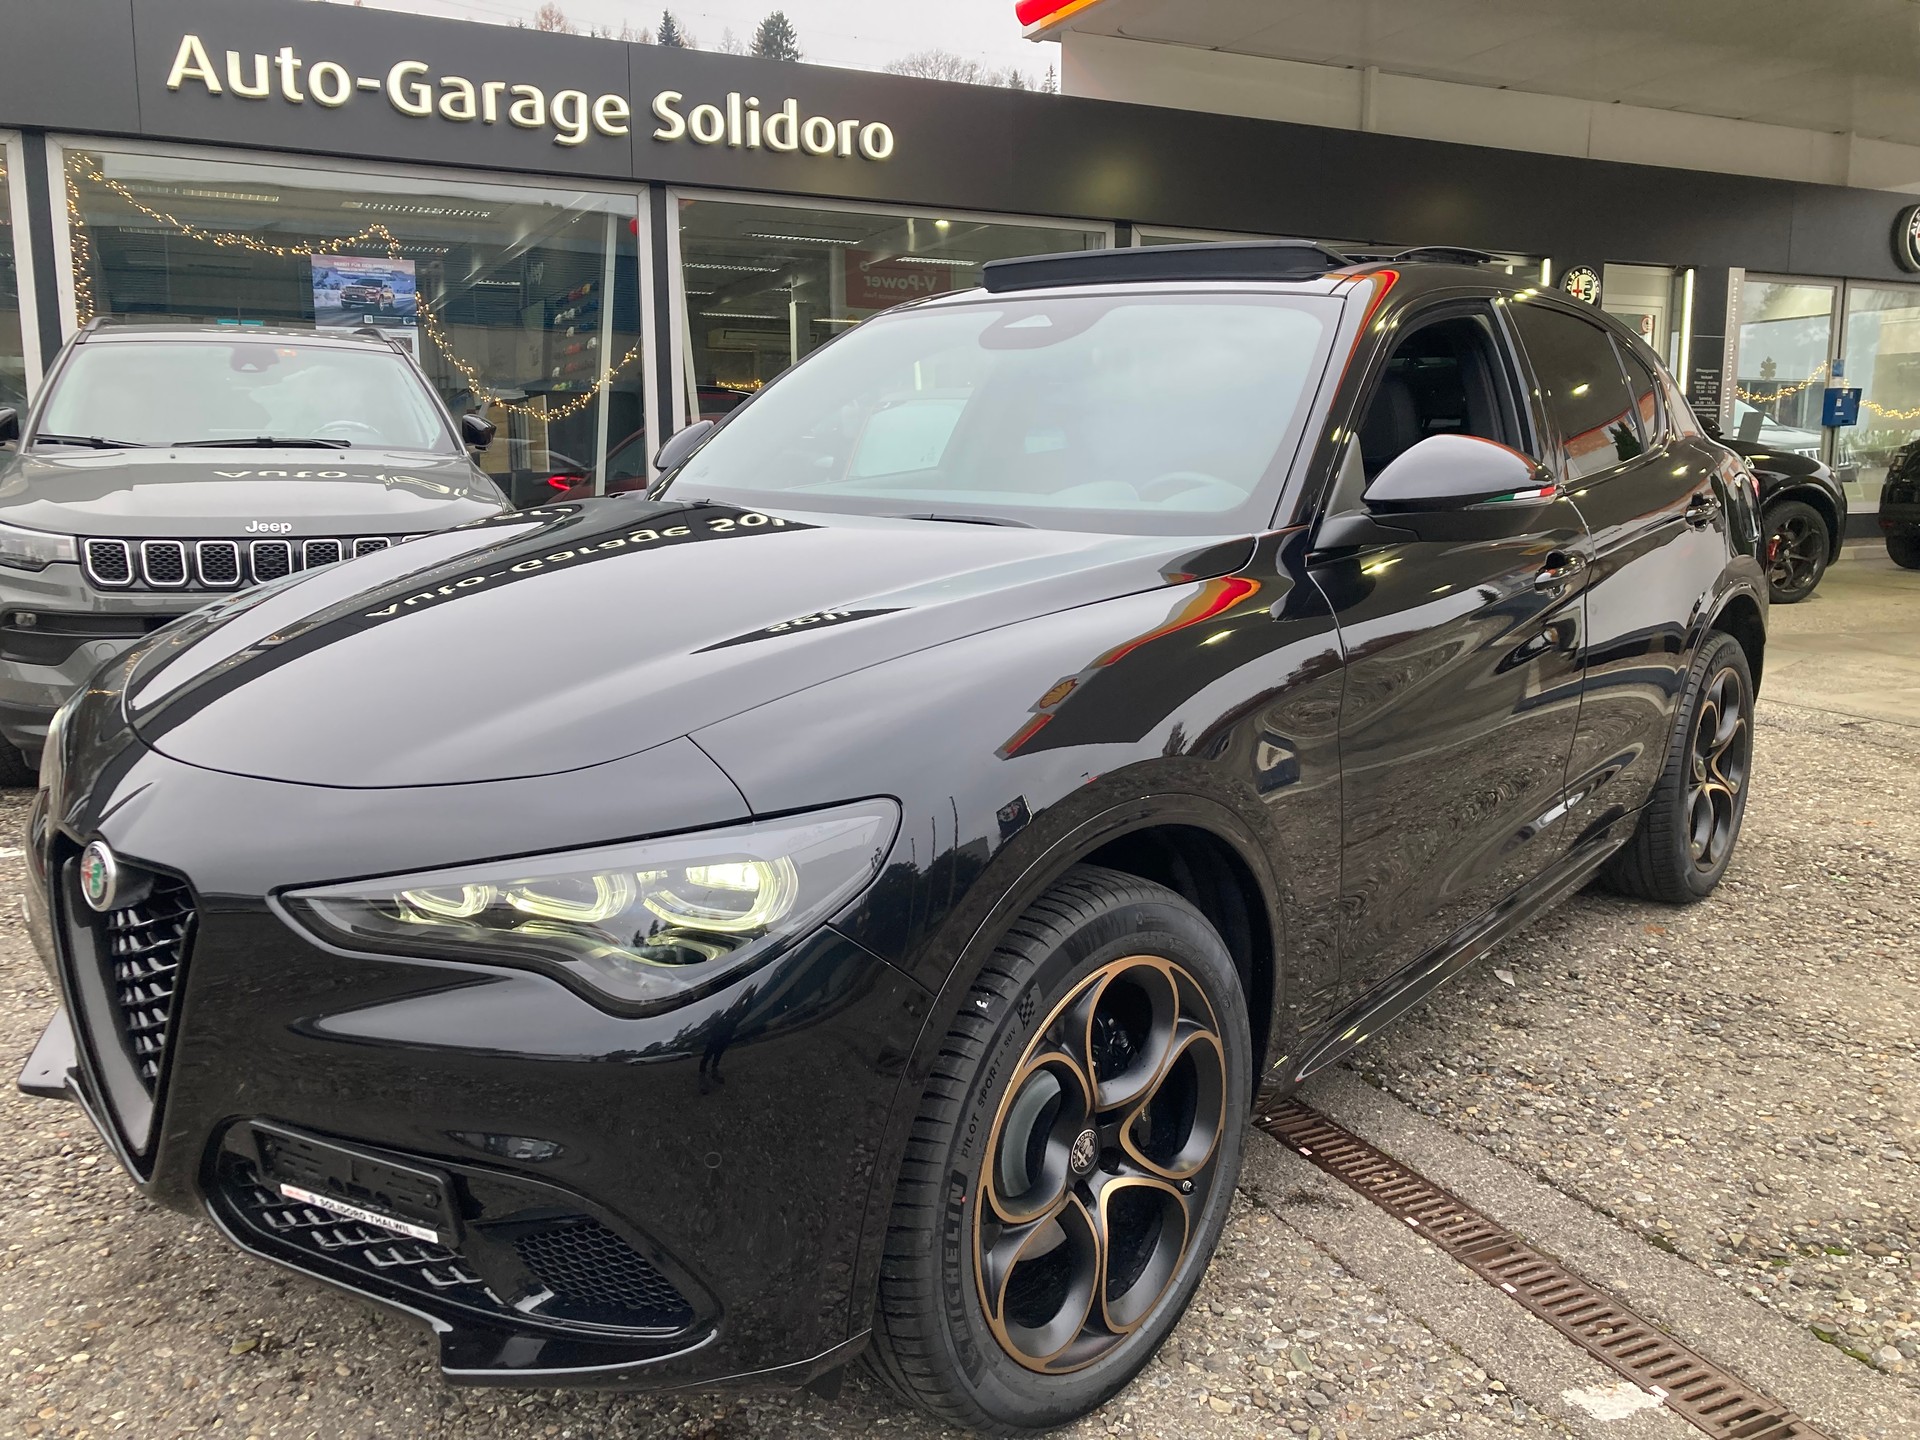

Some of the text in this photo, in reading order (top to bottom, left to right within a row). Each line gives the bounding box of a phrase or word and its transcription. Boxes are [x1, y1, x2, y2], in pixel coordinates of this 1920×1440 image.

[165, 33, 896, 162] Auto-Garage Solidoro
[245, 520, 292, 535] Jeep
[961, 1113, 980, 1158] PILOT
[978, 1057, 1001, 1108] SPORT
[1004, 1027, 1016, 1049] SUV
[319, 1198, 367, 1221] SOLIDORO
[369, 1213, 412, 1234] THALWIL
[944, 1182, 970, 1342] MICHELIN
